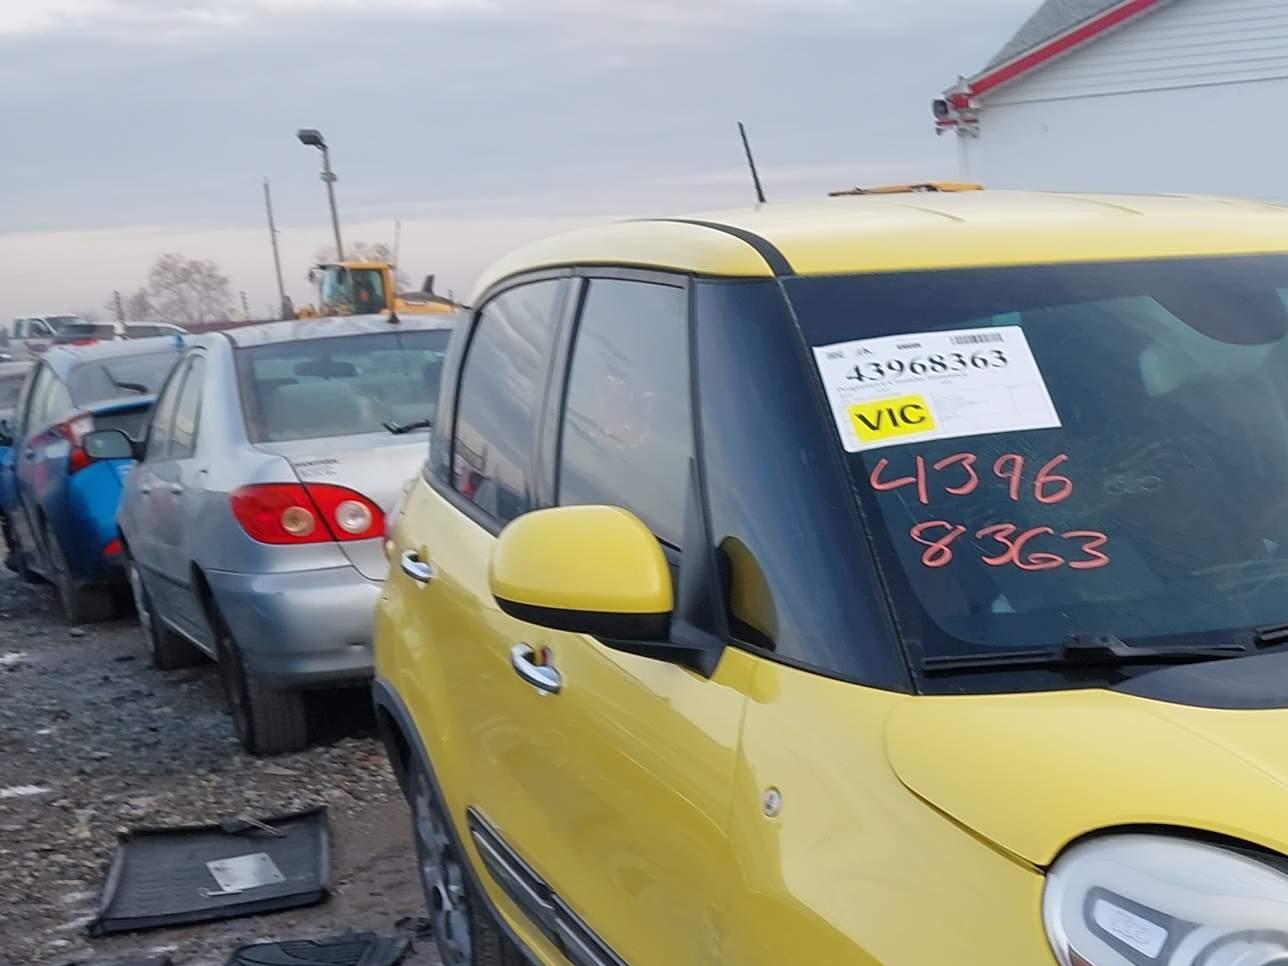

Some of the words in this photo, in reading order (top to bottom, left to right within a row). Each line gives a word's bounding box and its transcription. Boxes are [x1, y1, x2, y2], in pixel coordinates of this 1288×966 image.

[846, 349, 1009, 383] 43968363
[854, 403, 926, 432] VIC
[869, 453, 1073, 505] 4396
[910, 520, 1111, 571] 8363
